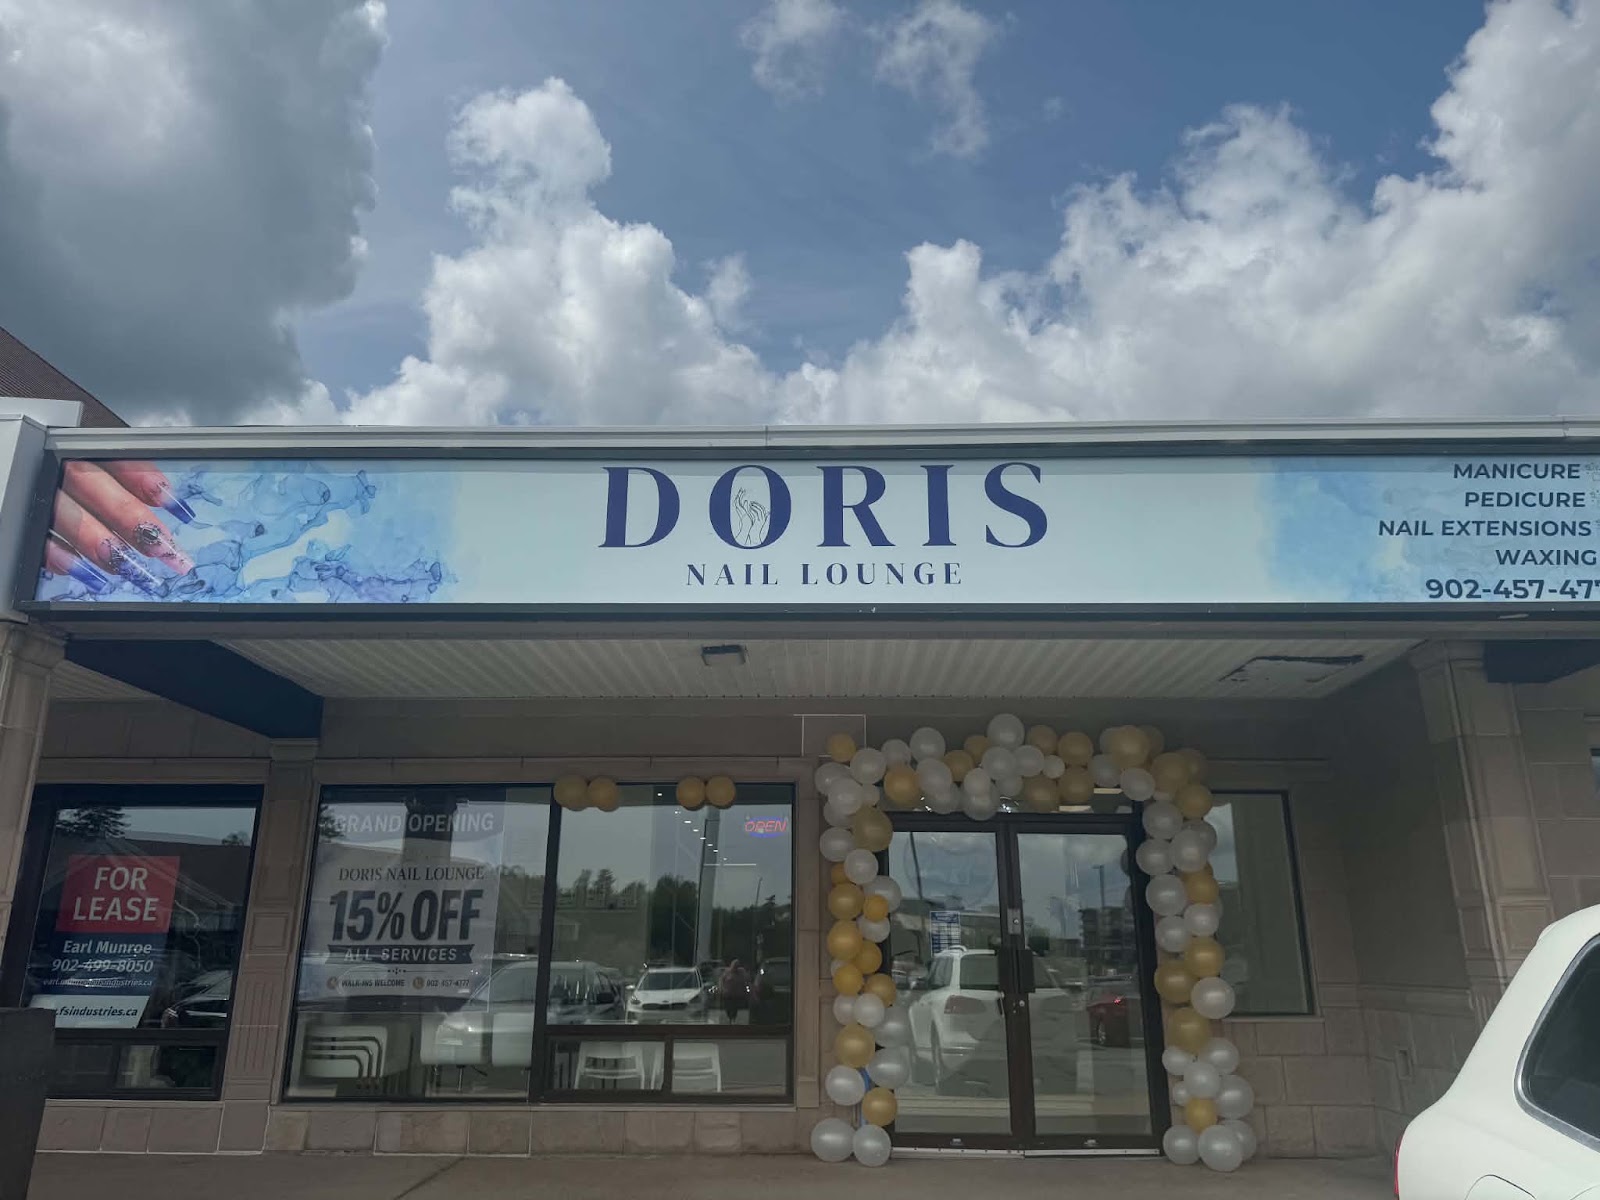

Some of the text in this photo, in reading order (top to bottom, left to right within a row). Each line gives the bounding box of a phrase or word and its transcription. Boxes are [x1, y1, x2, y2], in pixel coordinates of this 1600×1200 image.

[1453, 463, 1581, 480] MANICURE
[598, 462, 1048, 549] DORIS
[1464, 491, 1586, 508] PEDICURE
[1378, 520, 1592, 537] NAIL EXTENSIONS
[1495, 549, 1597, 566] WAXING
[686, 562, 962, 586] NAIL LOUNGE
[334, 812, 494, 833] GRAND OPENING
[744, 820, 787, 833] OPEN
[94, 866, 149, 891] FOR
[338, 866, 485, 882] DORIS NAIL LOUNGE
[73, 896, 159, 922] LEASE
[329, 889, 484, 942] 15% OFF
[63, 939, 153, 954] Earl Munroe
[343, 948, 457, 962] ALL SERVICES
[51, 958, 154, 974] 902-499-8050
[374, 979, 405, 987] WELCOME
